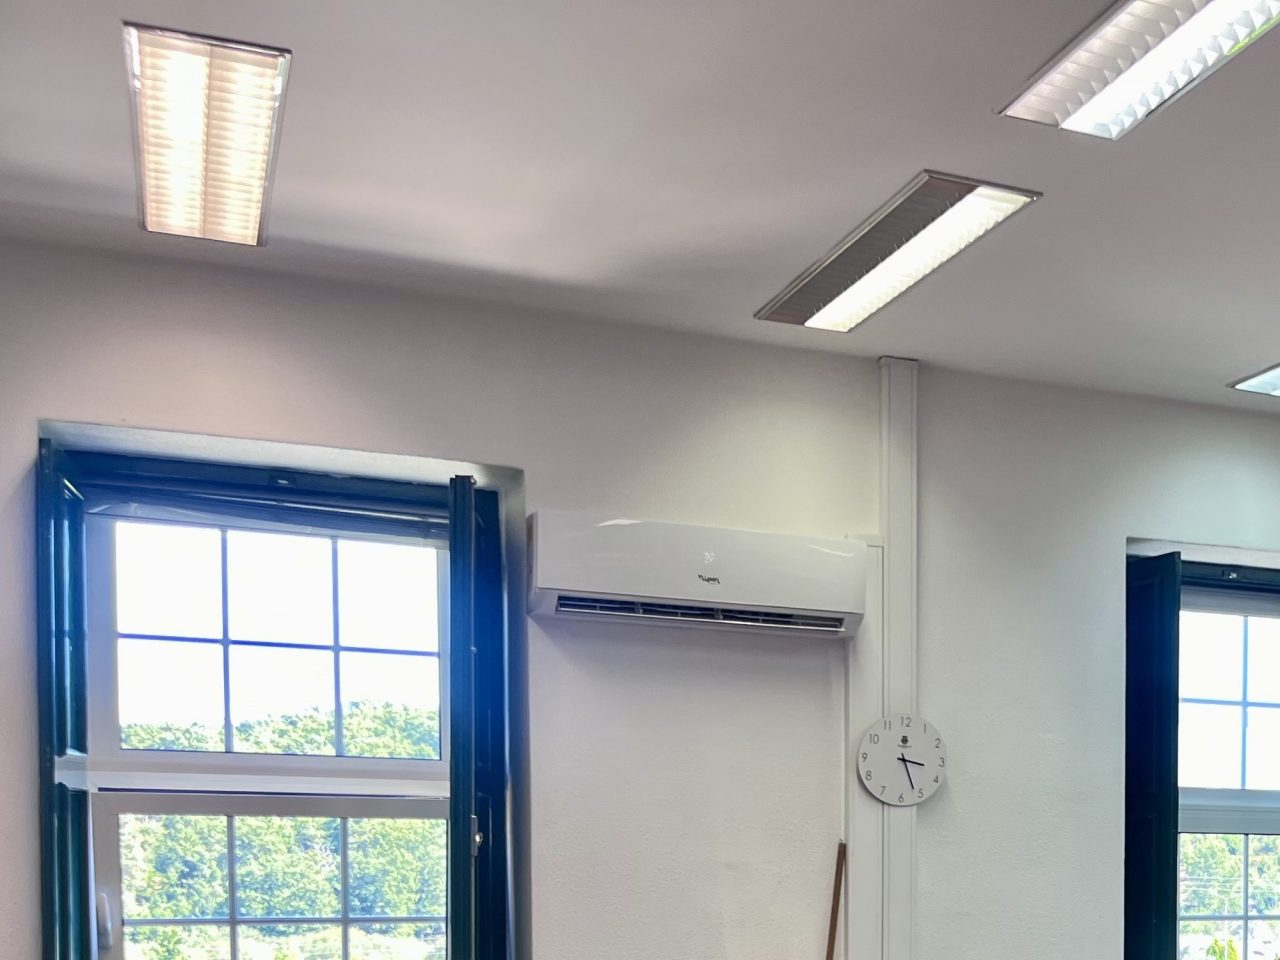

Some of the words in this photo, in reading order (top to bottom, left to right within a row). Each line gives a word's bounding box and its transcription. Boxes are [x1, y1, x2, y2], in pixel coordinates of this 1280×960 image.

[883, 720, 892, 731] 11
[900, 716, 912, 727] 12
[869, 733, 880, 744] 10
[934, 738, 941, 748] 2
[861, 752, 868, 763] 9
[939, 757, 945, 767] 3
[865, 770, 872, 781] 8
[932, 775, 939, 784] 4
[880, 785, 886, 795] 7
[917, 788, 924, 798] 5
[898, 793, 904, 803] 6
